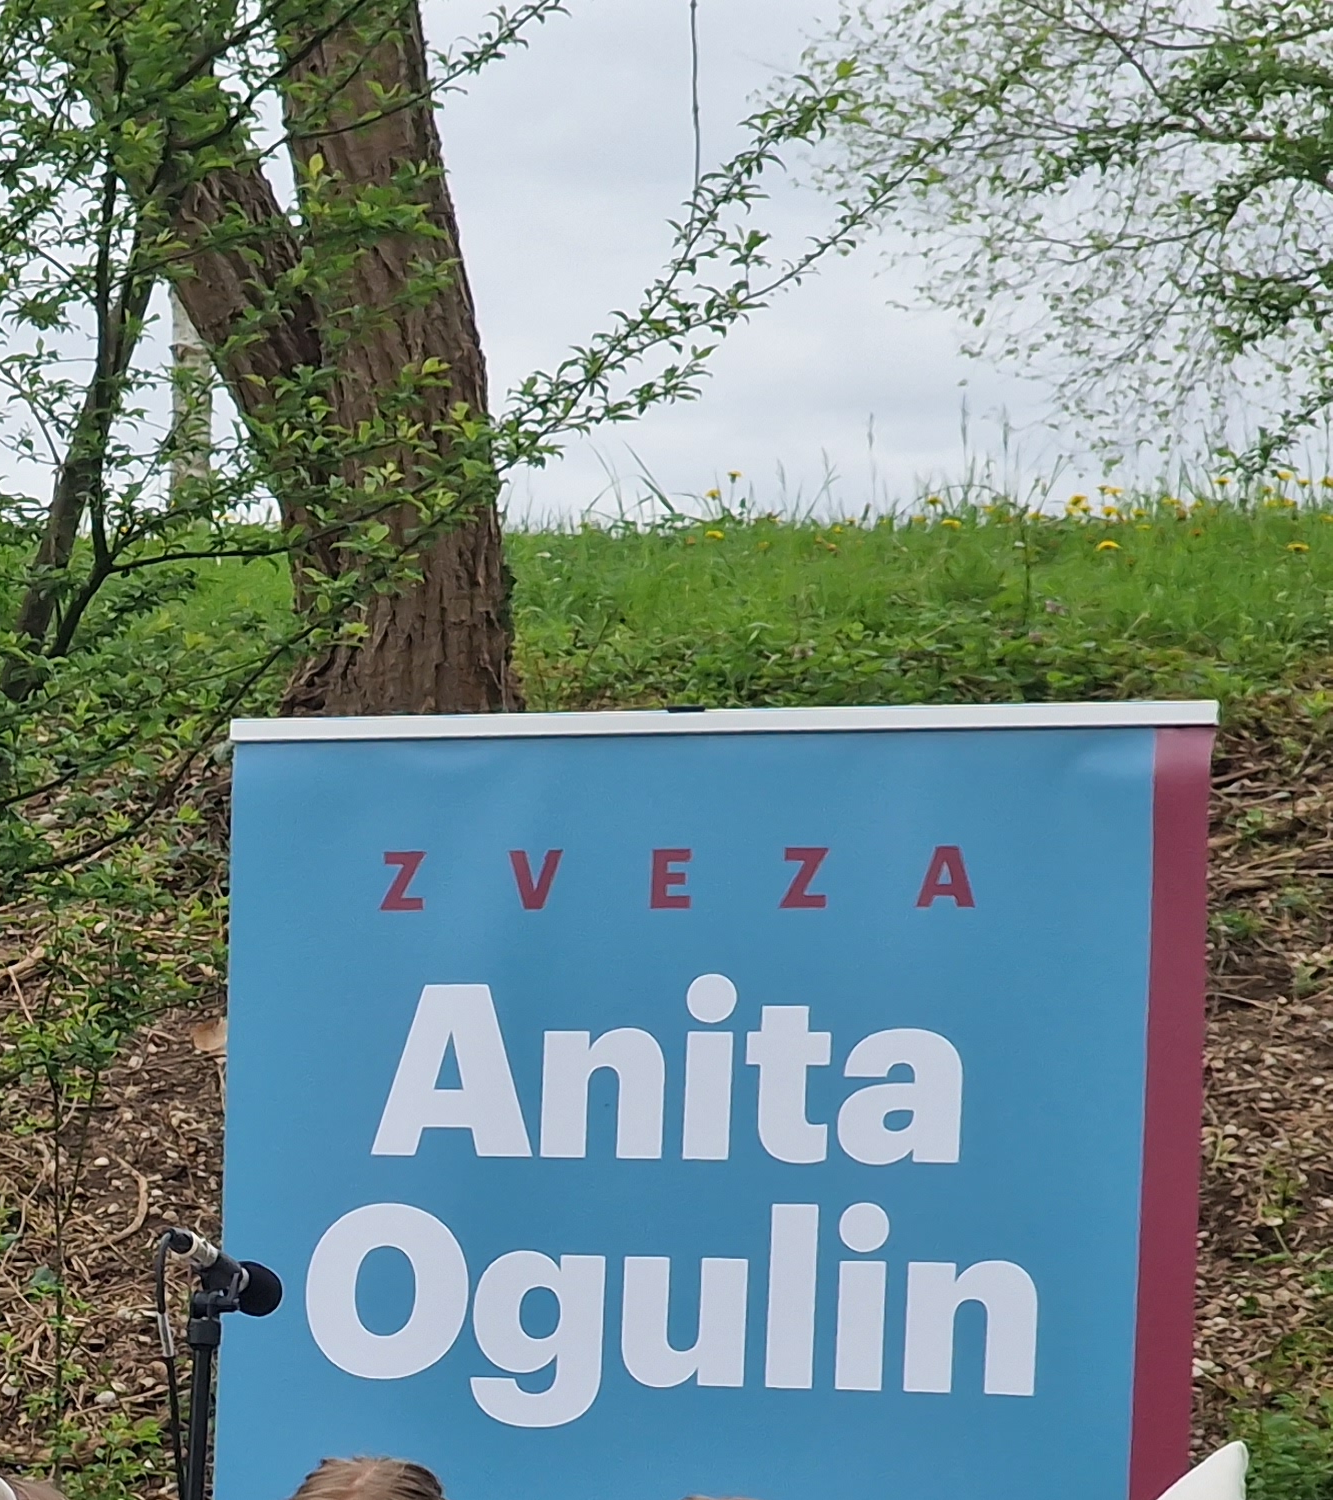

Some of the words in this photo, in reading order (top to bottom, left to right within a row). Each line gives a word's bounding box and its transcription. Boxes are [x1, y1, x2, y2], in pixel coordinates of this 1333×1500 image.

[379, 845, 975, 912] ZVEZA
[370, 973, 964, 1166] Anita
[305, 1201, 1040, 1428] Ogulin
